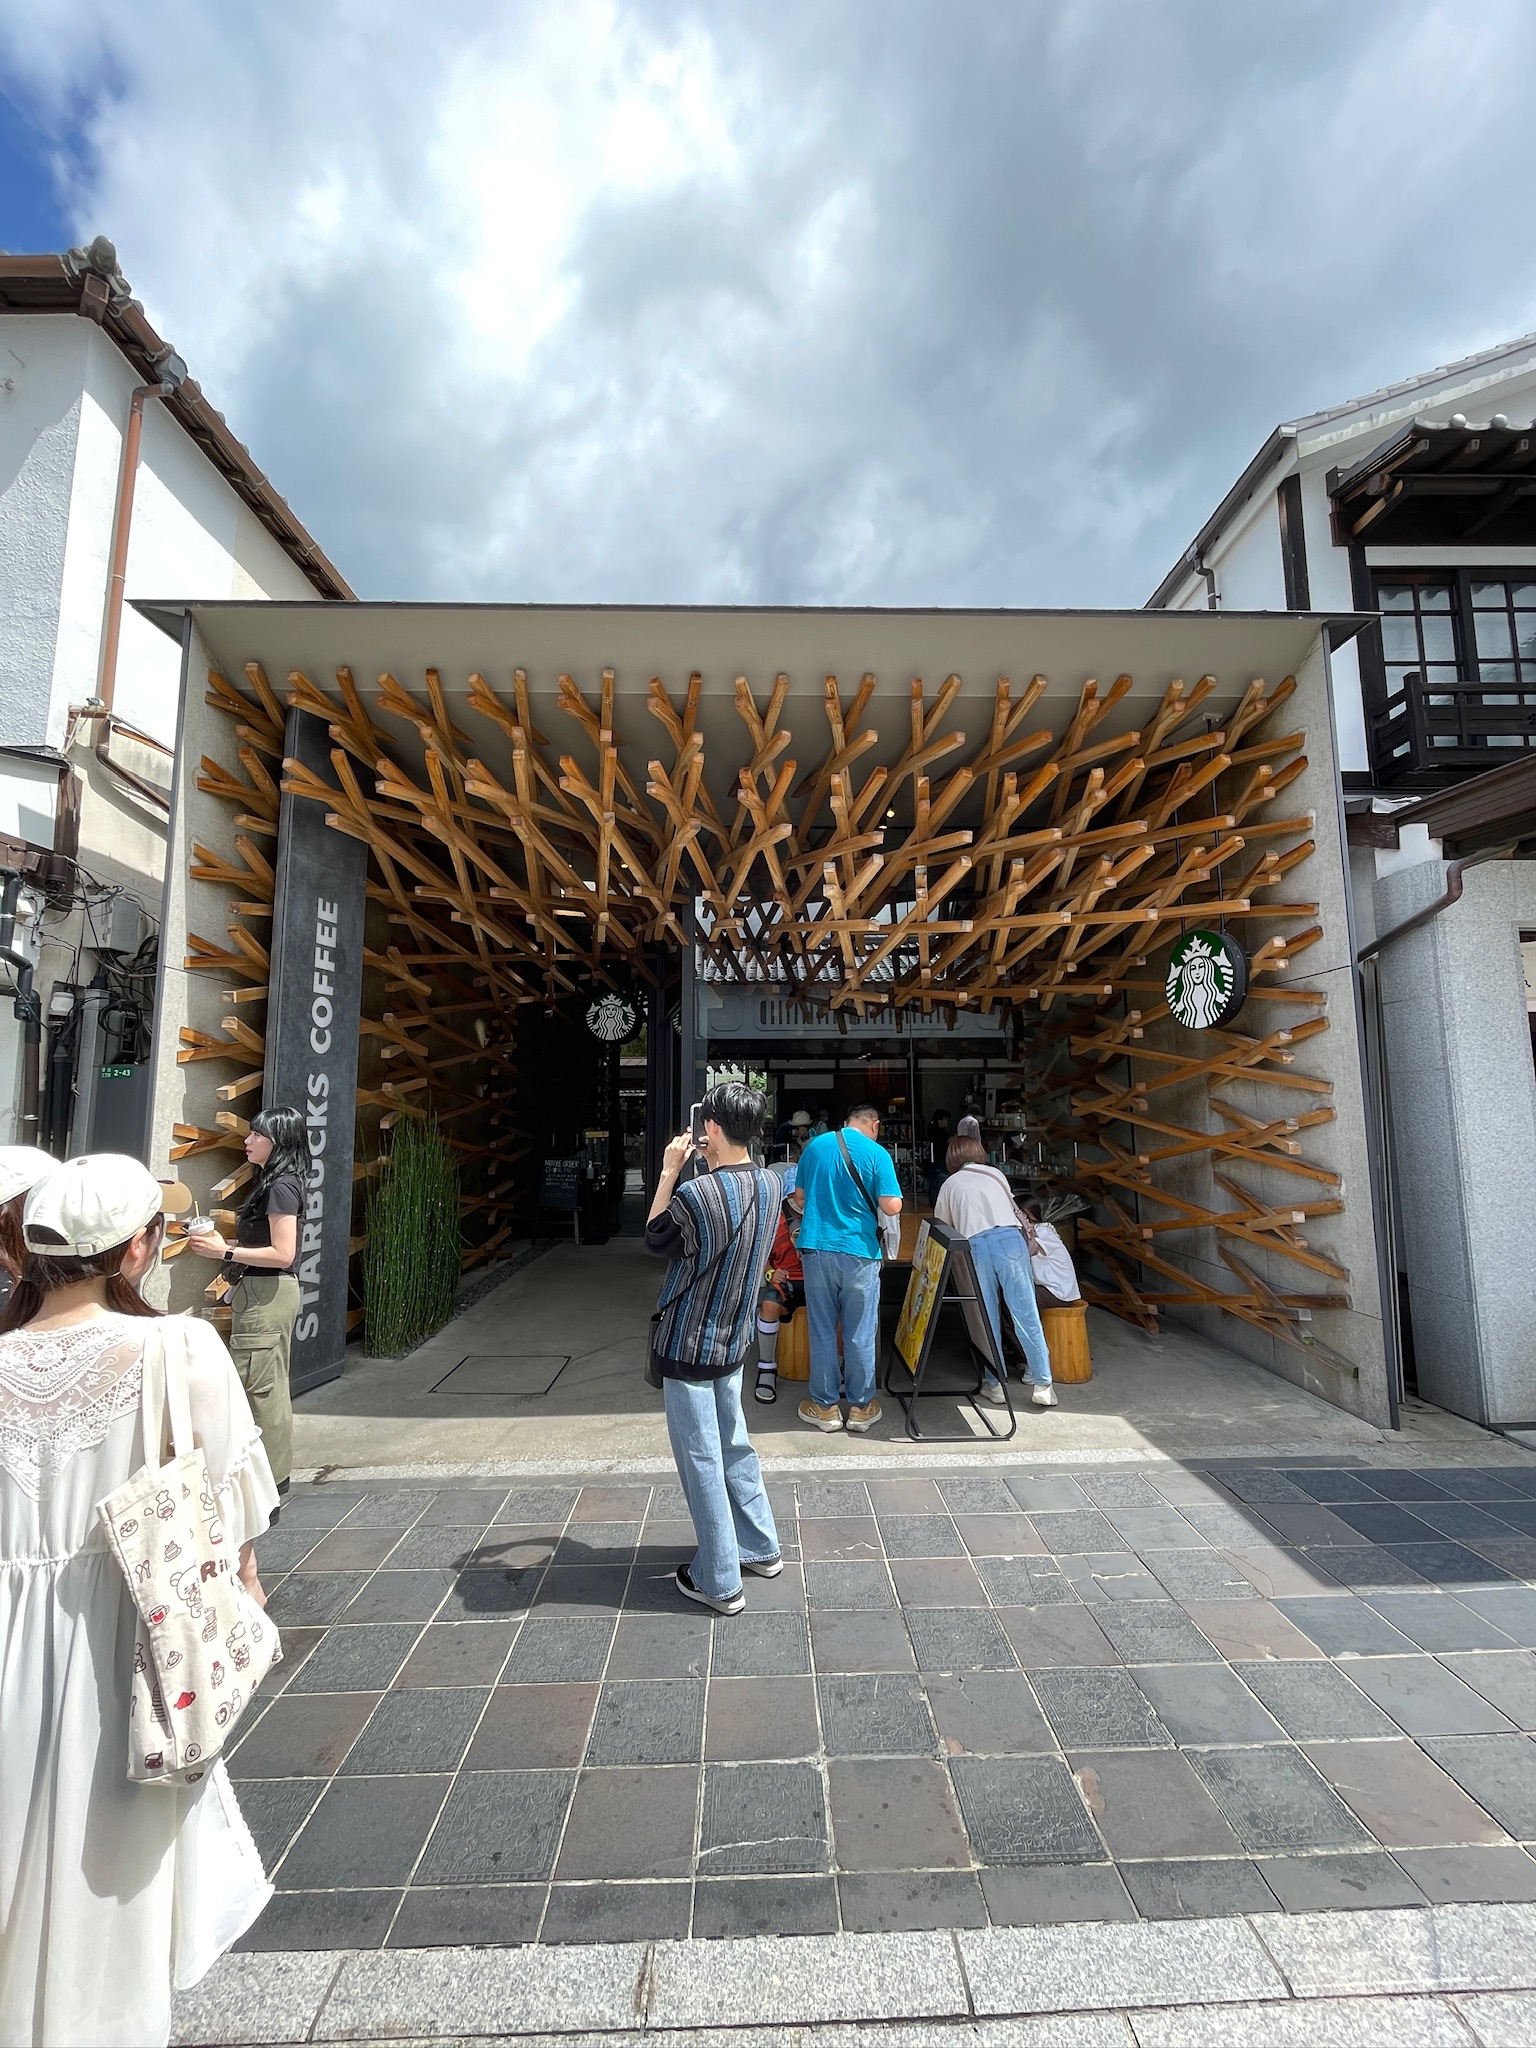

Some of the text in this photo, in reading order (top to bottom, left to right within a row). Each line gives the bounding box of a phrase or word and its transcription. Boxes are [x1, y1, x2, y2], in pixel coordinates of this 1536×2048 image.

[113, 1069, 131, 1077] 2-43
[296, 897, 339, 1342] STARBUCKS COFFEE
